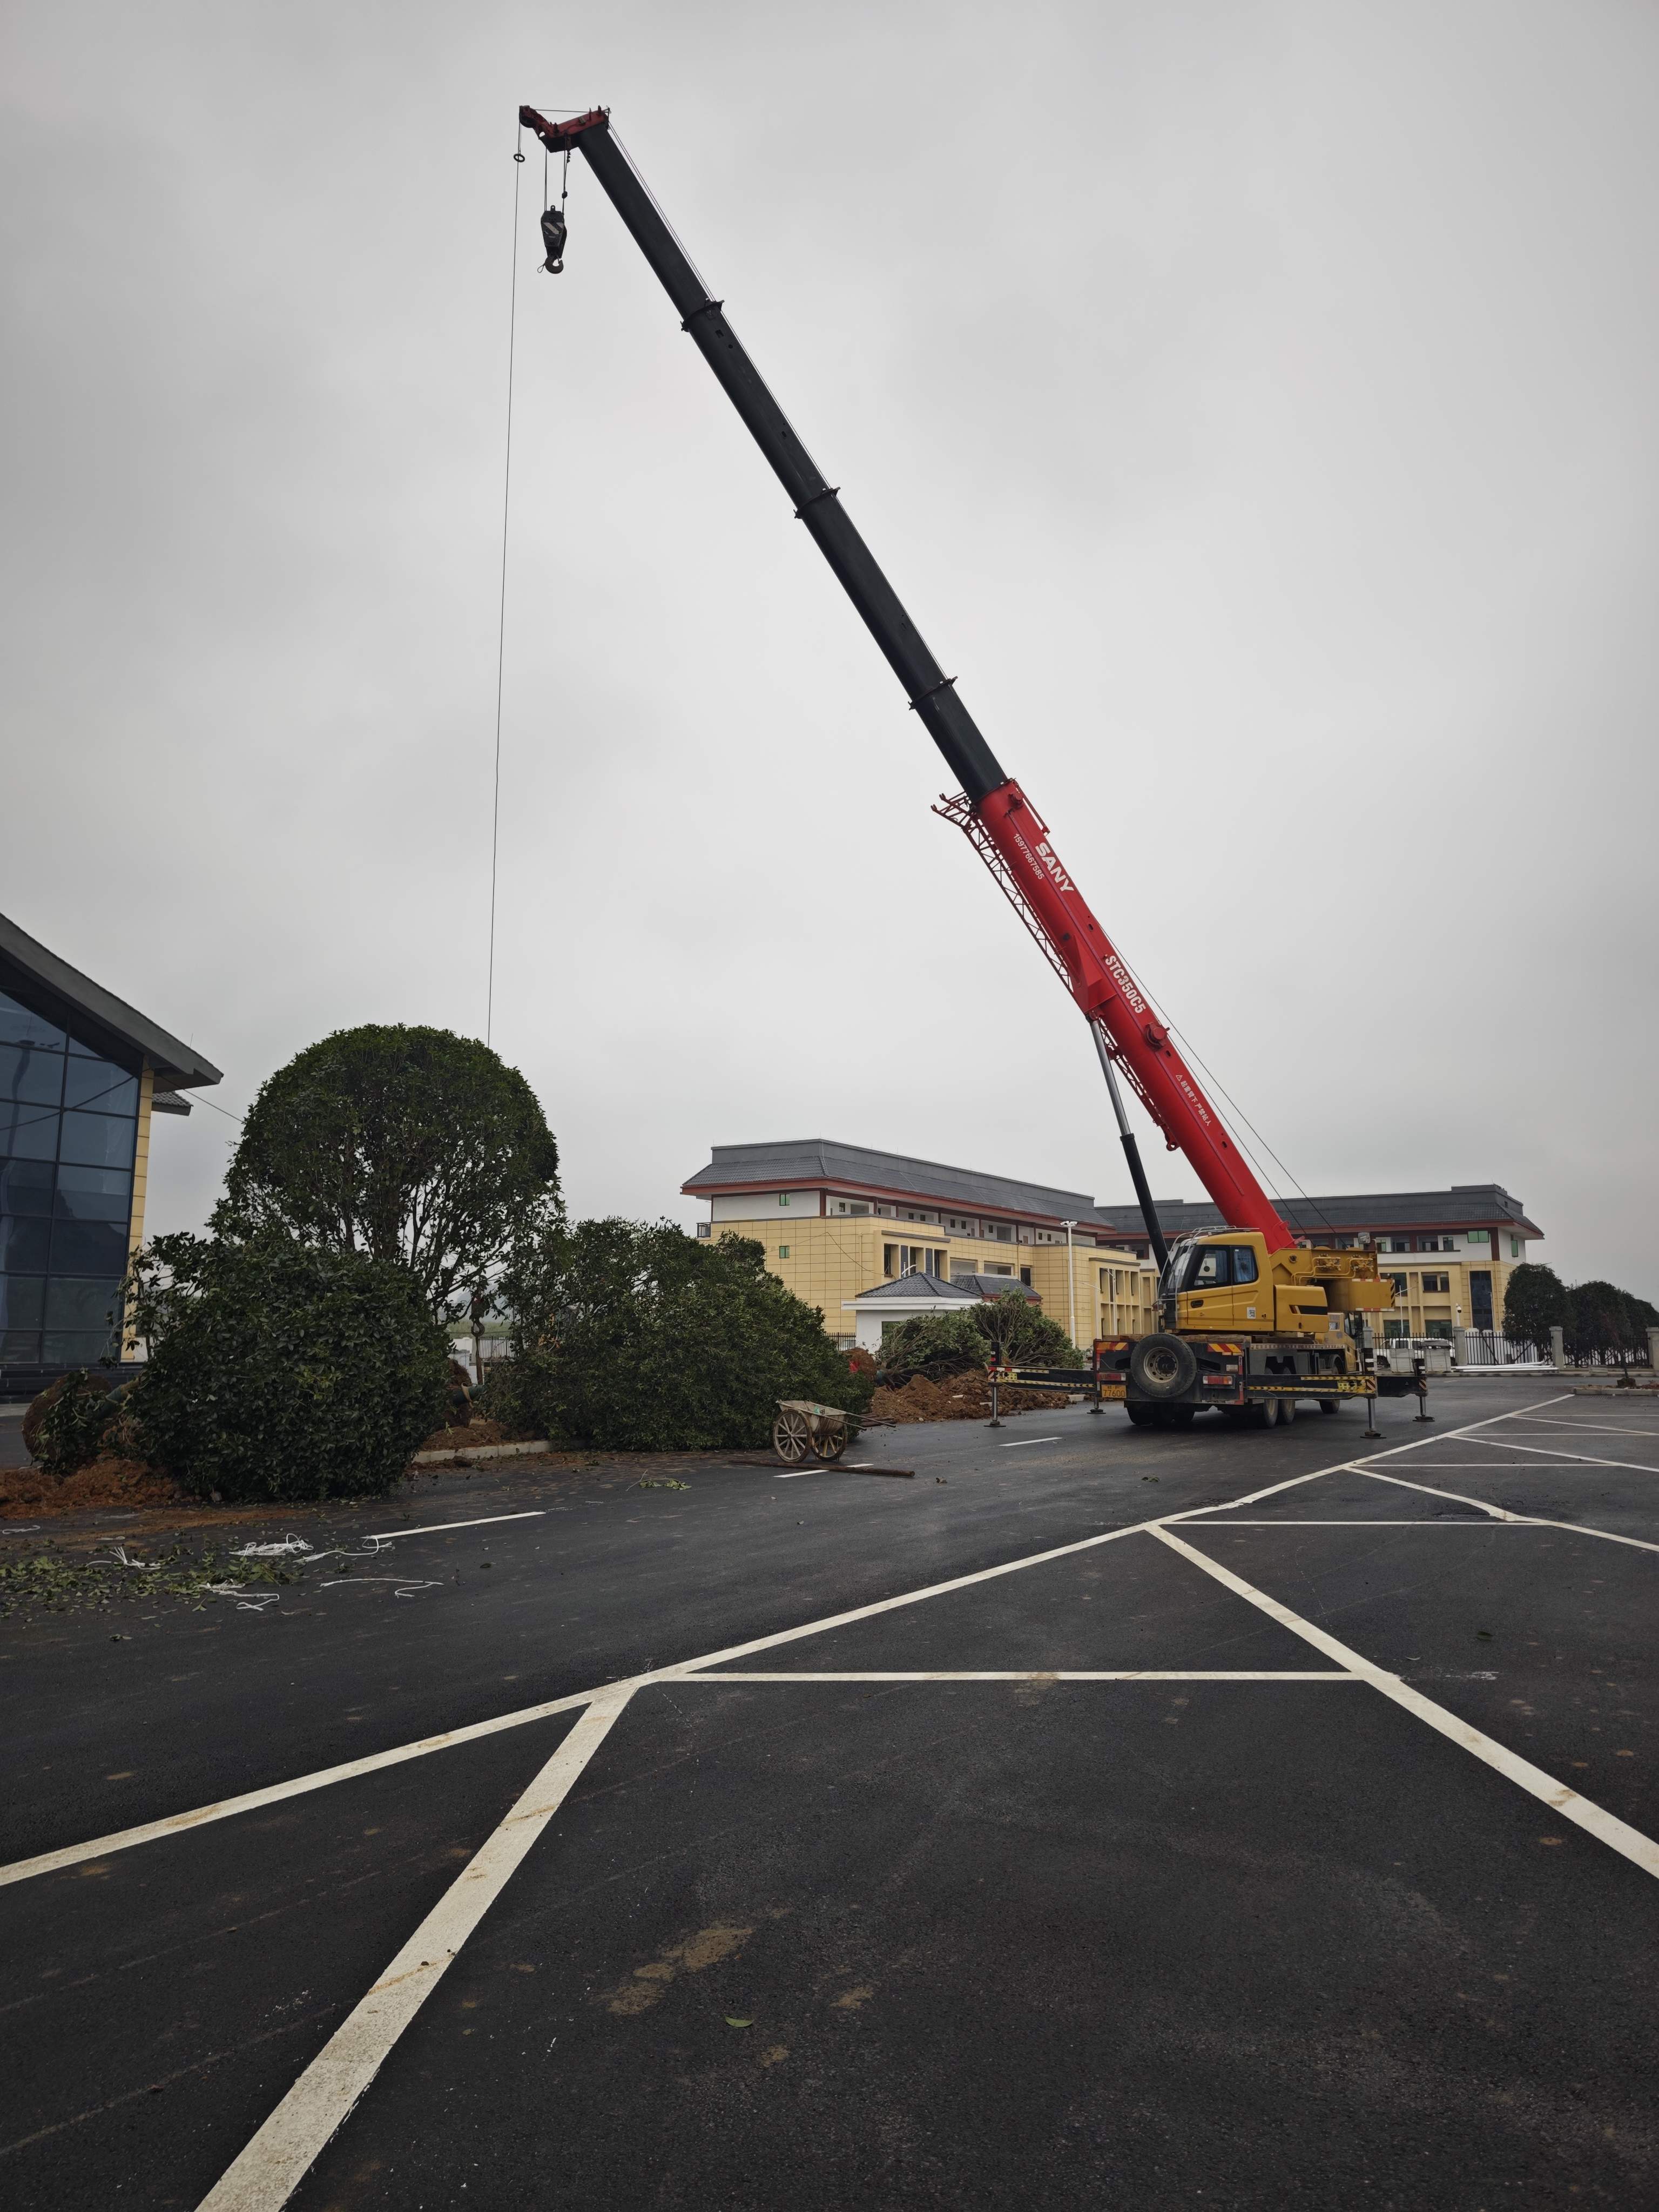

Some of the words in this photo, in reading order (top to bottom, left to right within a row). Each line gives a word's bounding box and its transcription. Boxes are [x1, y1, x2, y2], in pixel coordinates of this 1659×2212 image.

[1014, 833, 1044, 880] 15977667585
[1035, 842, 1074, 892] SANY
[1105, 955, 1146, 1014] STC350C5
